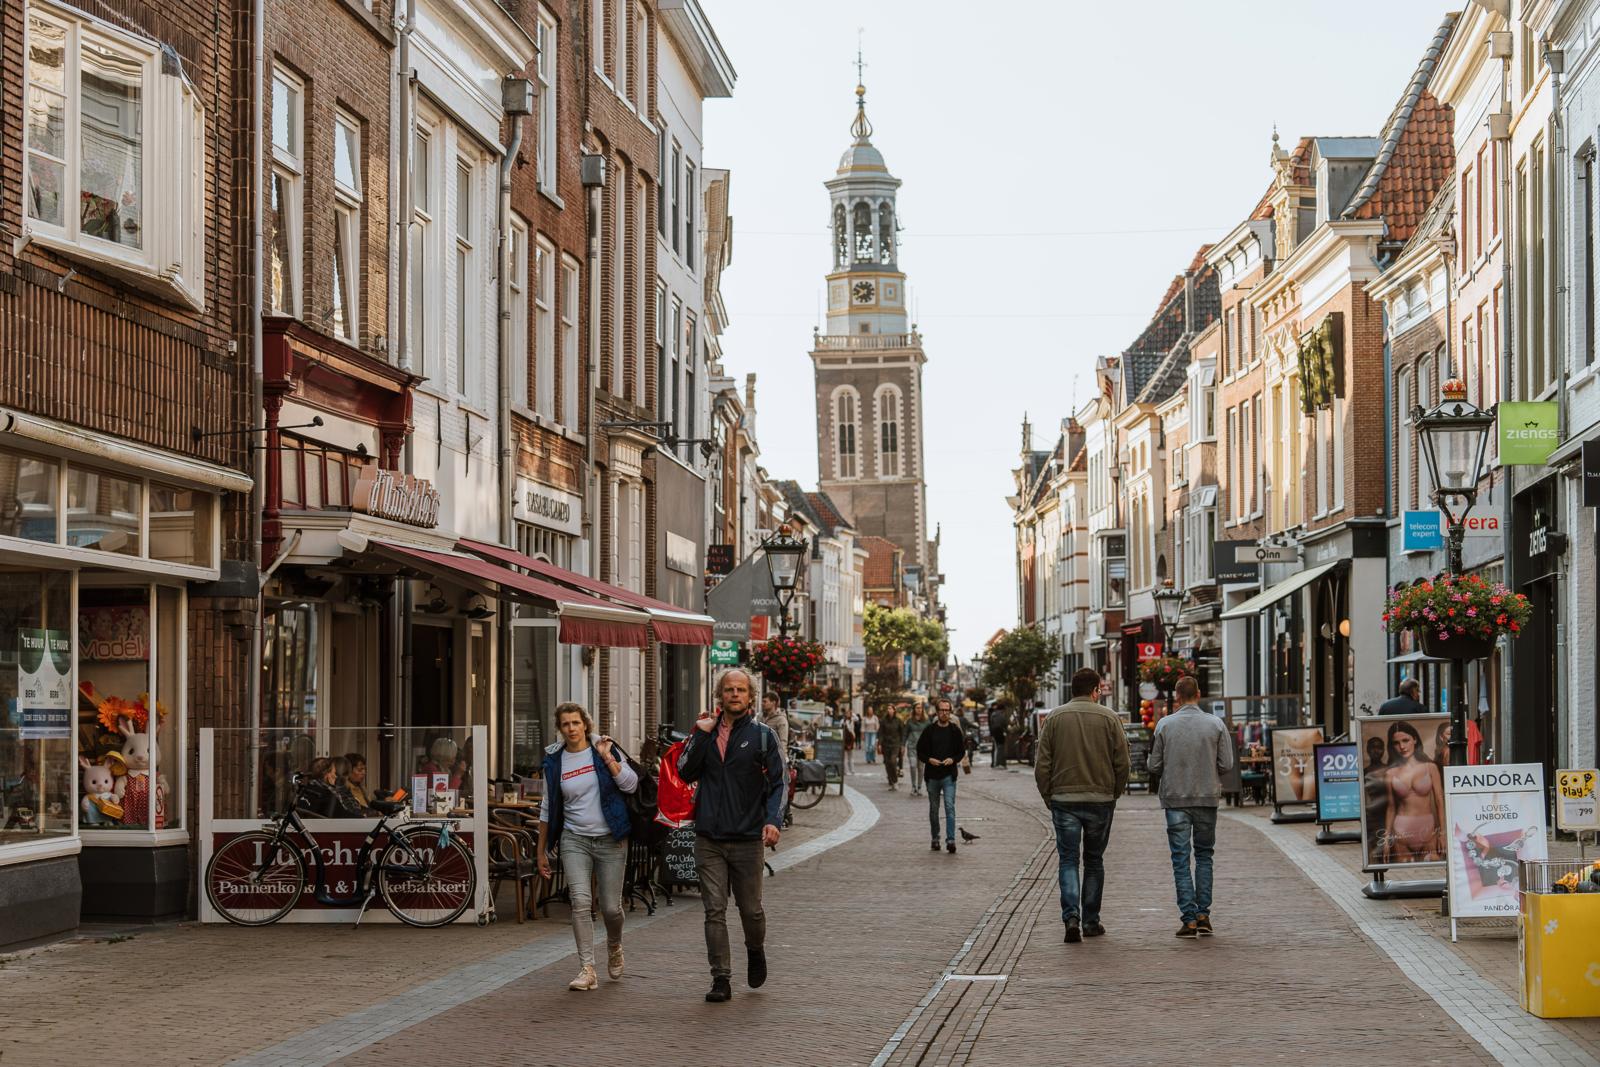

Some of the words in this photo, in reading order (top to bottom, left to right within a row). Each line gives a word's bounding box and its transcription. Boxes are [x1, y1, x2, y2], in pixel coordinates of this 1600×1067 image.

[1506, 429, 1558, 439] ZIENGS
[1409, 522, 1438, 530] telecom
[1446, 513, 1499, 530] rvera
[24, 637, 30, 648] TE
[31, 638, 45, 649] HUUR
[50, 639, 57, 650] TE
[57, 640, 69, 650] HUUR
[711, 648, 738, 657] Pearle
[1322, 754, 1359, 771] 20%
[1475, 812, 1519, 821] UNBOXED
[252, 839, 437, 867] Lunchoom
[335, 880, 348, 894] &
